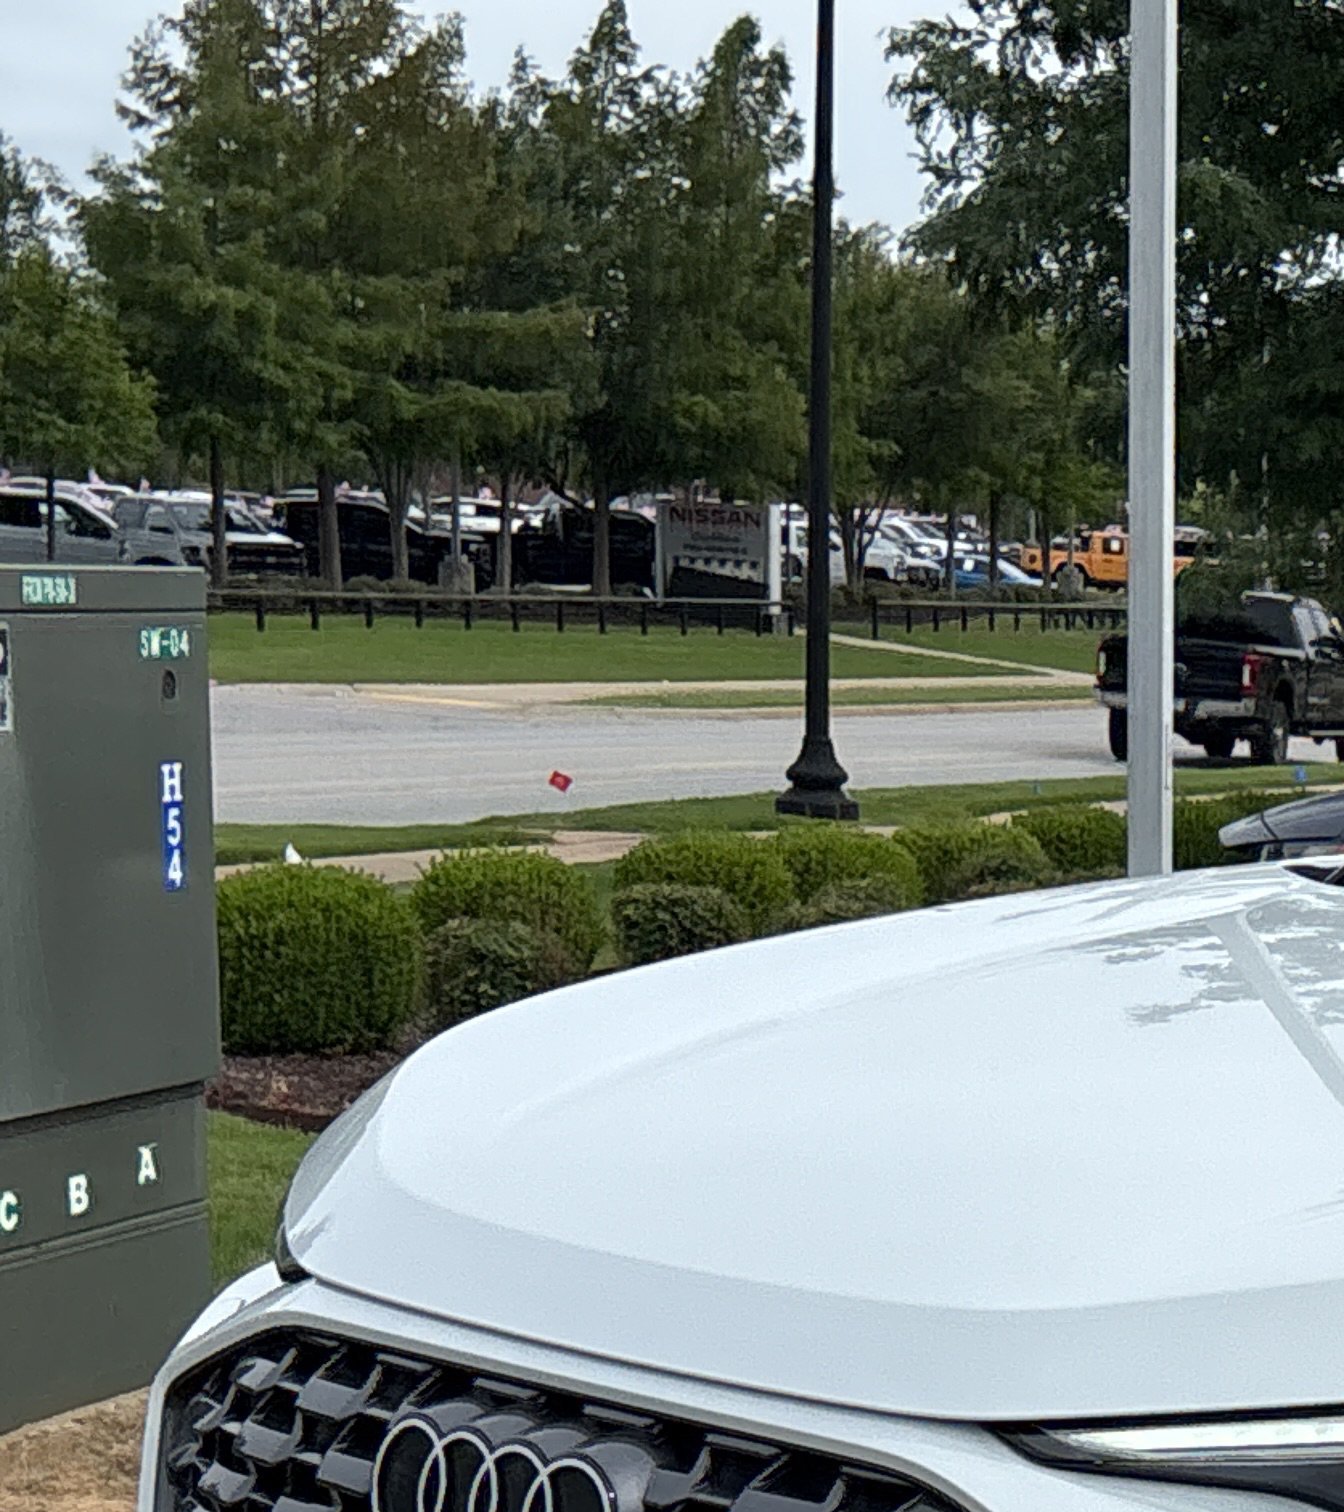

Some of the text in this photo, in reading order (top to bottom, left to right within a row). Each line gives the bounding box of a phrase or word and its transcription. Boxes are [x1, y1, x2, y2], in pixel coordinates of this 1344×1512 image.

[669, 506, 760, 528] NISSAN
[0, 1142, 158, 1231] C B A
